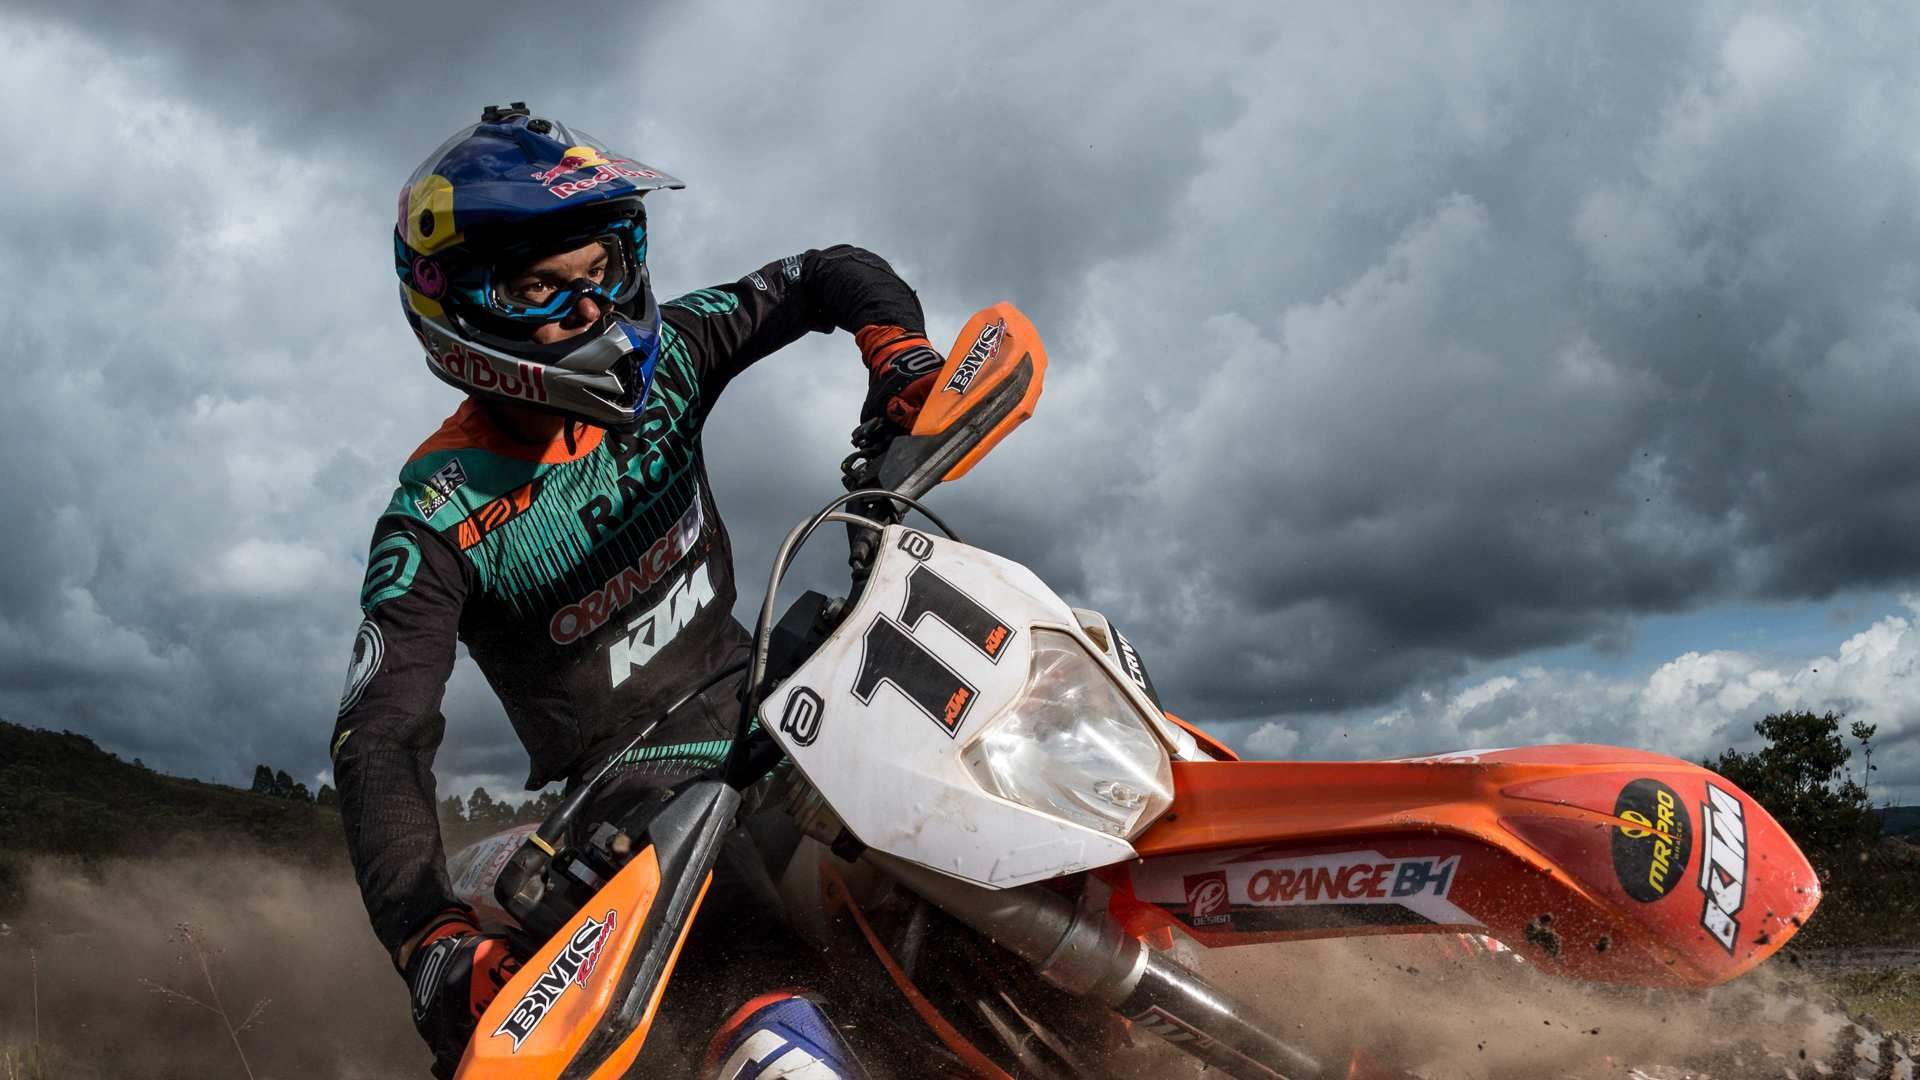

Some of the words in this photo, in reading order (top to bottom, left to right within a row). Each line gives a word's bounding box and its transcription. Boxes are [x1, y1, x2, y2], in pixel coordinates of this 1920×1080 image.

[549, 164, 620, 199] Red
[466, 349, 547, 402] Bull
[942, 322, 1000, 395] BMS
[609, 562, 716, 689] KTM
[985, 625, 1008, 655] KTM
[944, 687, 970, 727] KTM
[1698, 781, 1747, 954] KTM
[489, 915, 607, 1055] BMS
